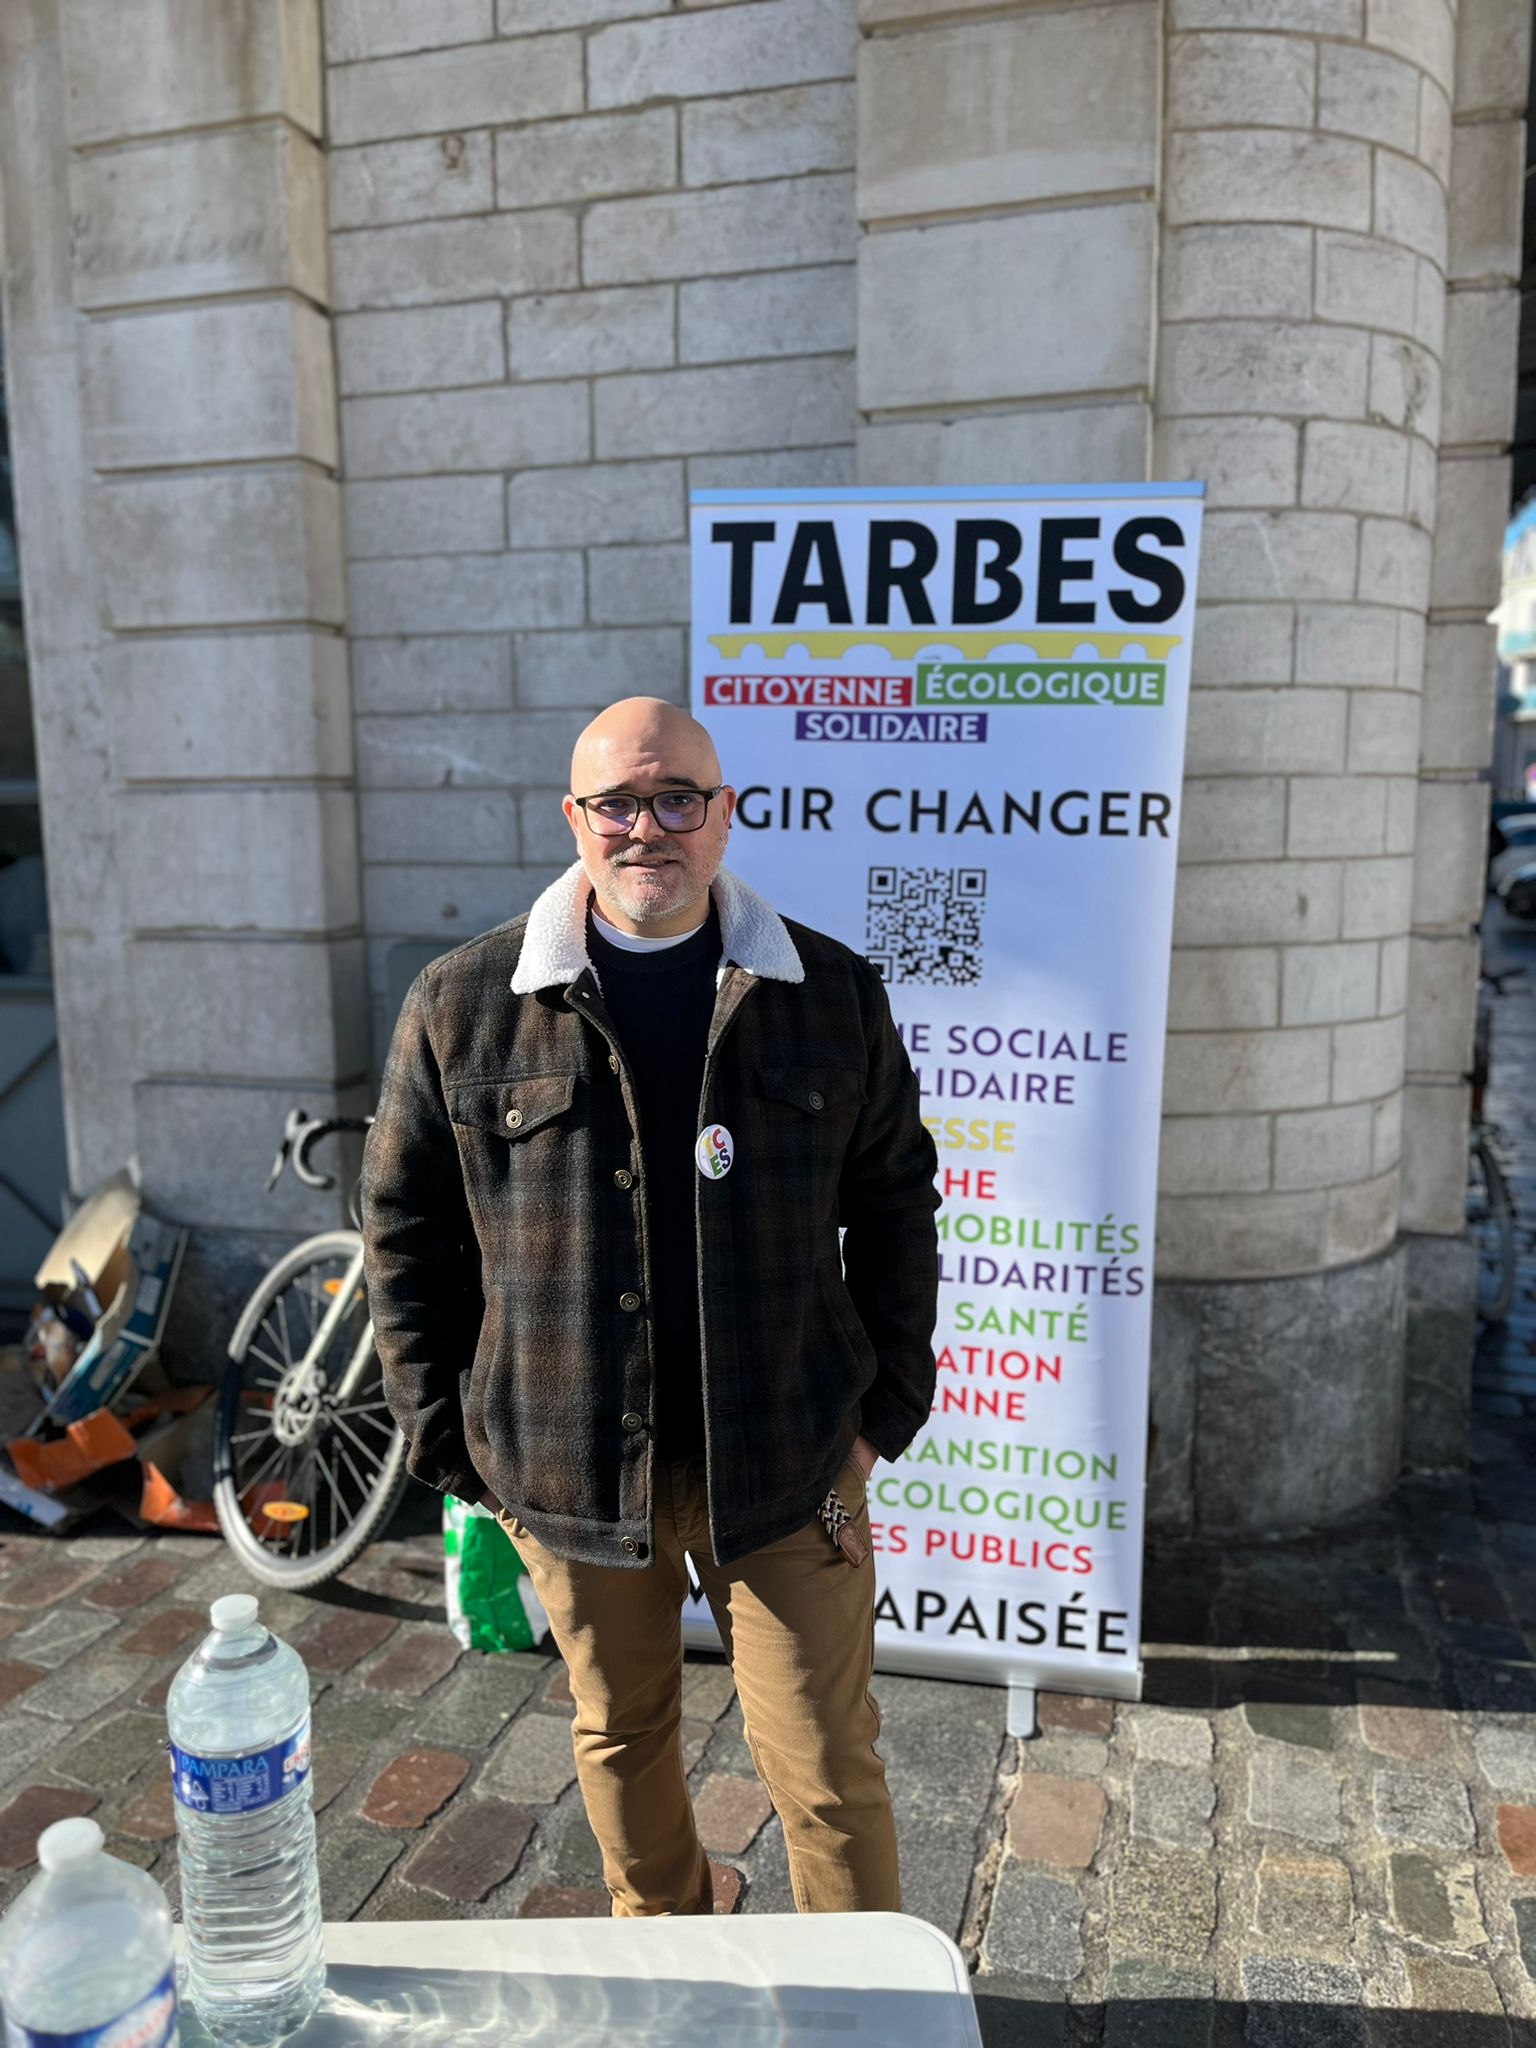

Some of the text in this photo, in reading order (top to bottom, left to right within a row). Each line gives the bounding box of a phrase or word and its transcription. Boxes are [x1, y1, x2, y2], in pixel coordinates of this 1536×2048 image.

[711, 517, 1186, 625] TARBES
[711, 665, 1160, 705] CITOYENNE ÉCOLOGIQUE
[804, 714, 979, 741] SOLIDAIRE
[730, 786, 1172, 838] GIR CHANGER
[947, 1025, 1128, 1063] SOCIALE
[936, 1168, 997, 1200] HE
[954, 1302, 1089, 1342] SANTÉ
[936, 1345, 1062, 1383] ATION
[930, 1386, 1027, 1421] NNE
[925, 1528, 1093, 1575] PUBLICS
[874, 1586, 1128, 1655] APAISÉE
